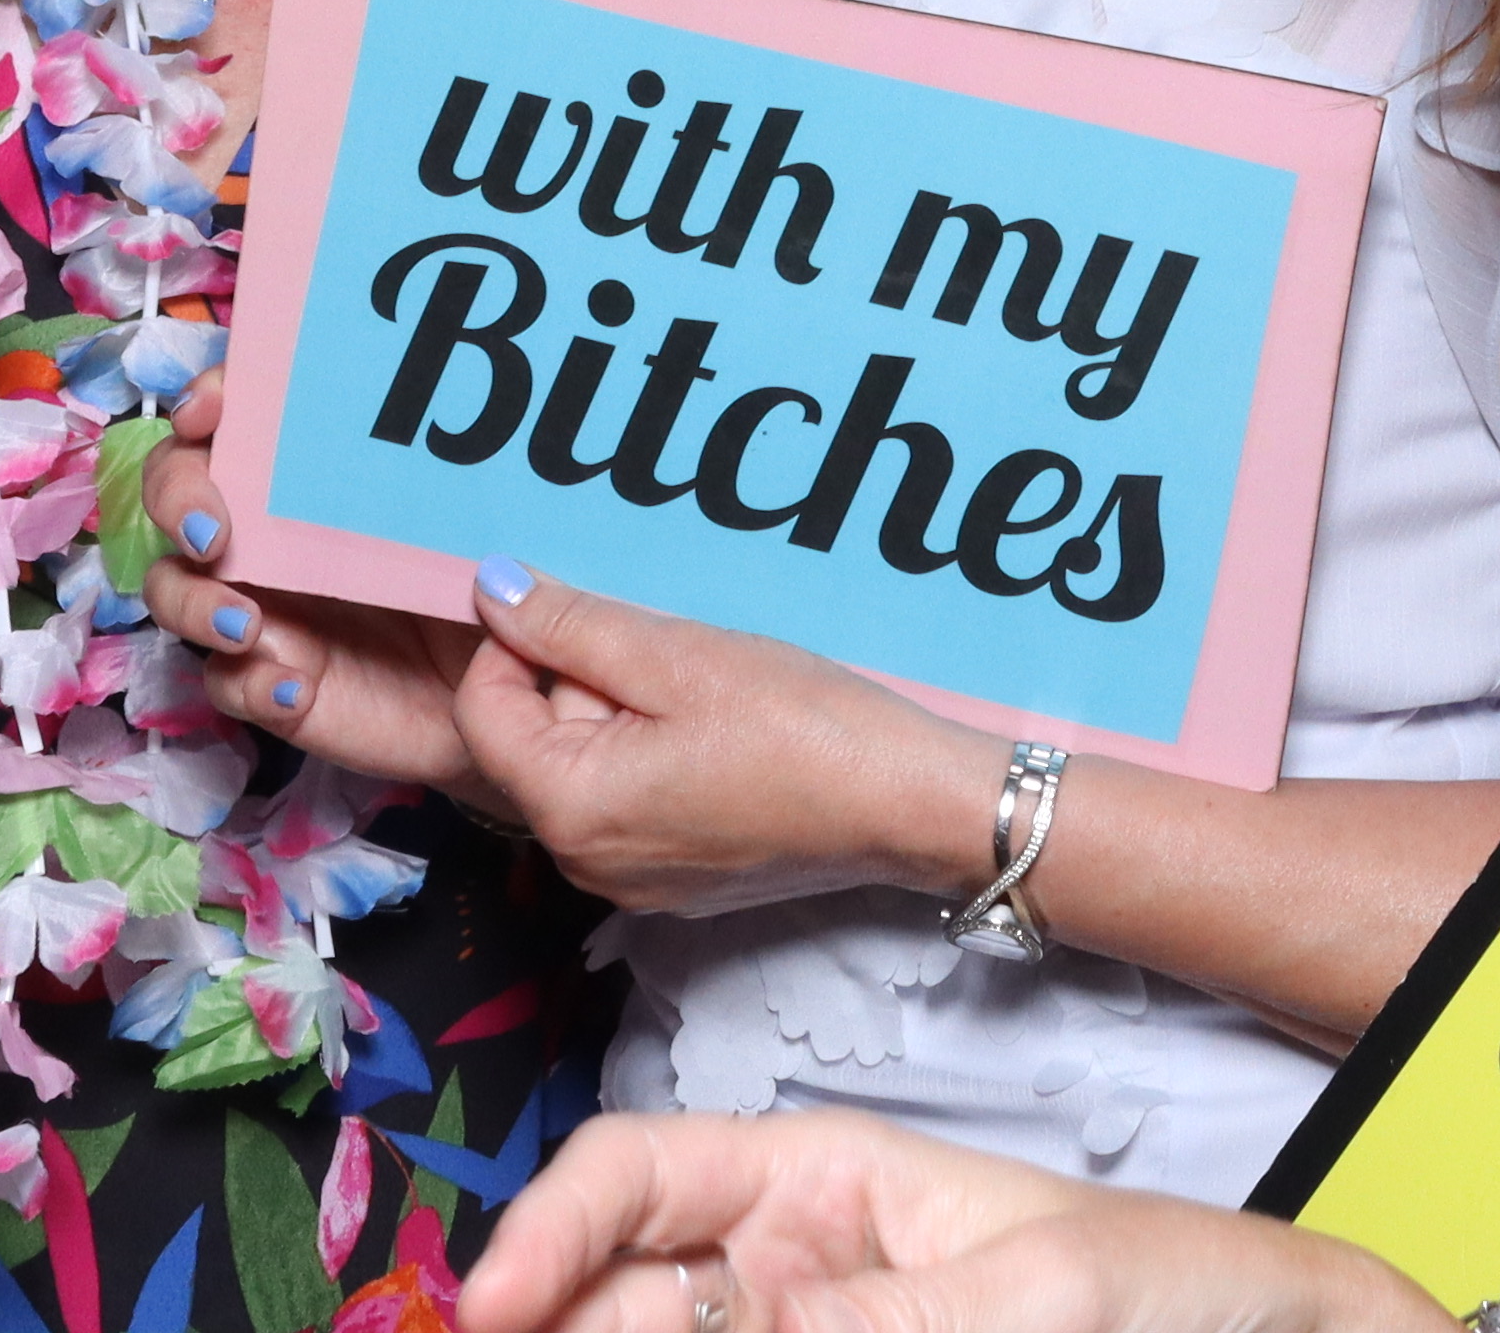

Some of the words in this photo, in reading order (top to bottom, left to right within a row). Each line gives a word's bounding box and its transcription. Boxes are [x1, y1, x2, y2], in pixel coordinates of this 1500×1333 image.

[369, 233, 1165, 623] Bitches
[418, 69, 835, 285] with
[869, 190, 1199, 421] my
